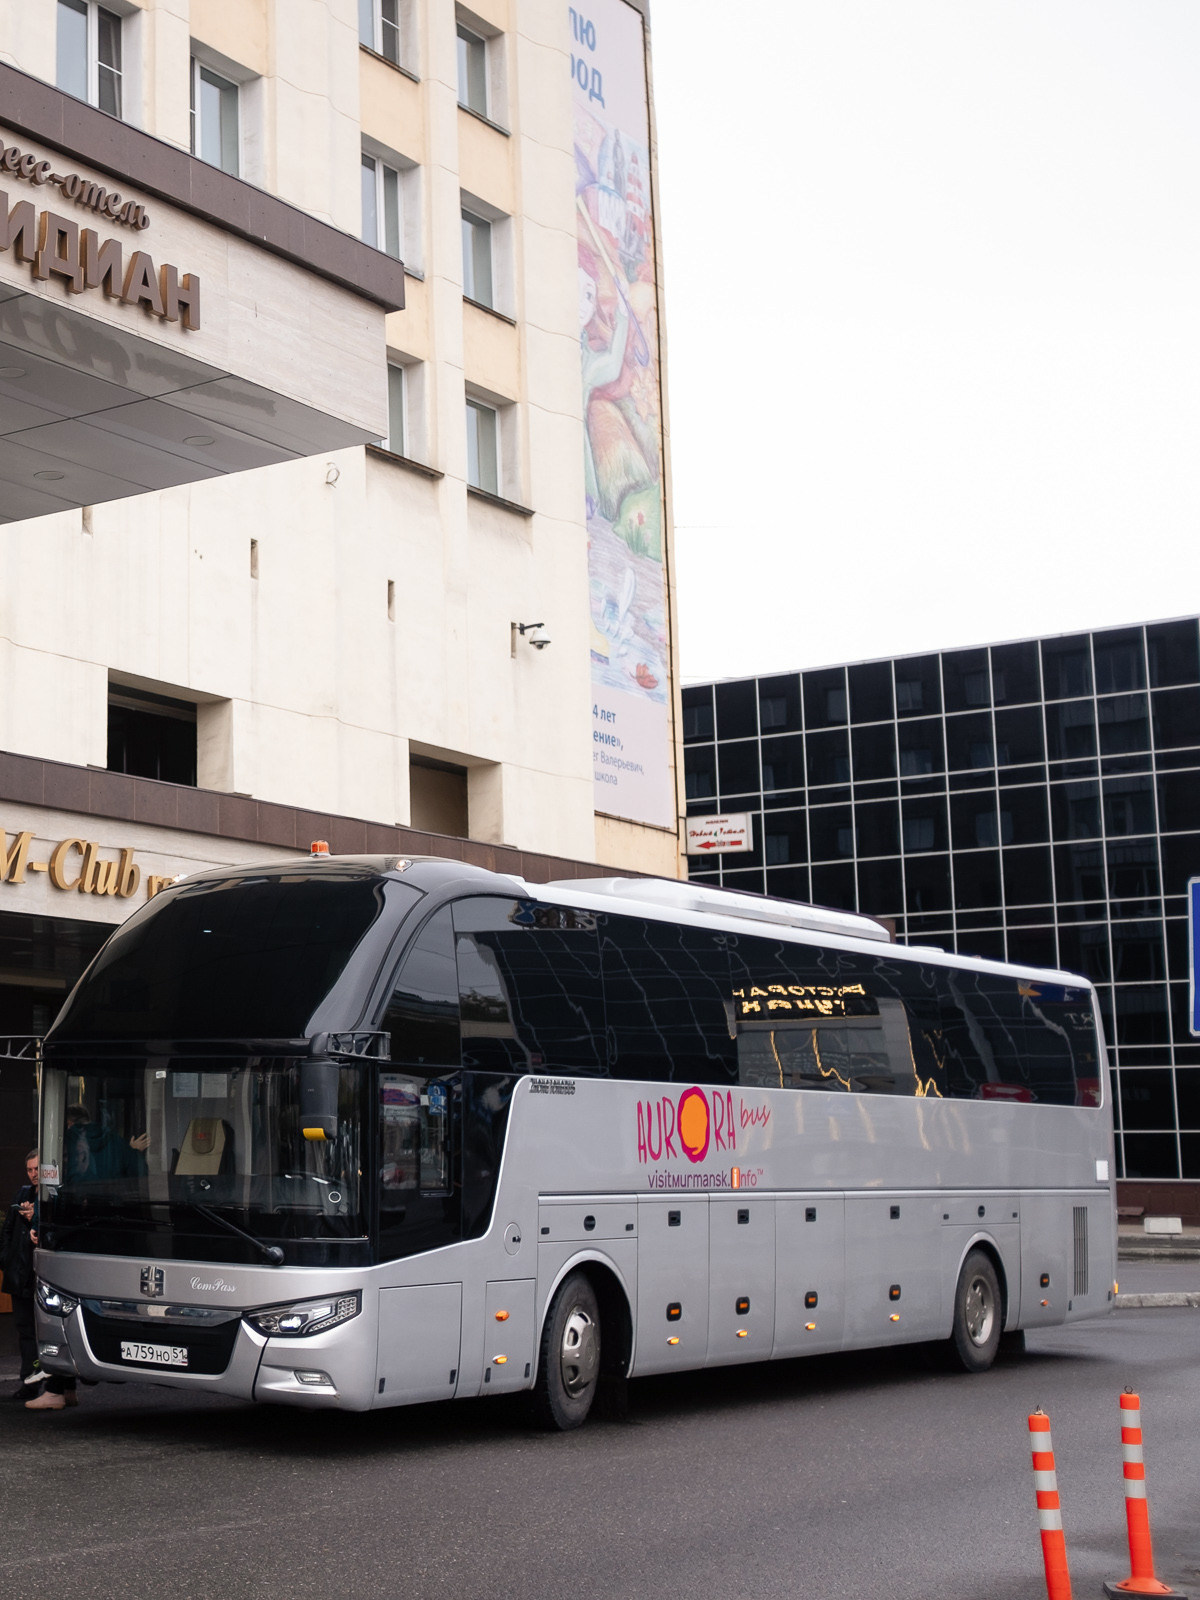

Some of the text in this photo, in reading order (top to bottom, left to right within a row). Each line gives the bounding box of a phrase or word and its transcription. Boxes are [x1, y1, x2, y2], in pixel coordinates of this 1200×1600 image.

[570, 52, 606, 110] ОД
[600, 708, 617, 724] лет
[594, 770, 618, 786] школа
[637, 1086, 771, 1164] AURORA bus
[190, 1276, 237, 1293] ComPass
